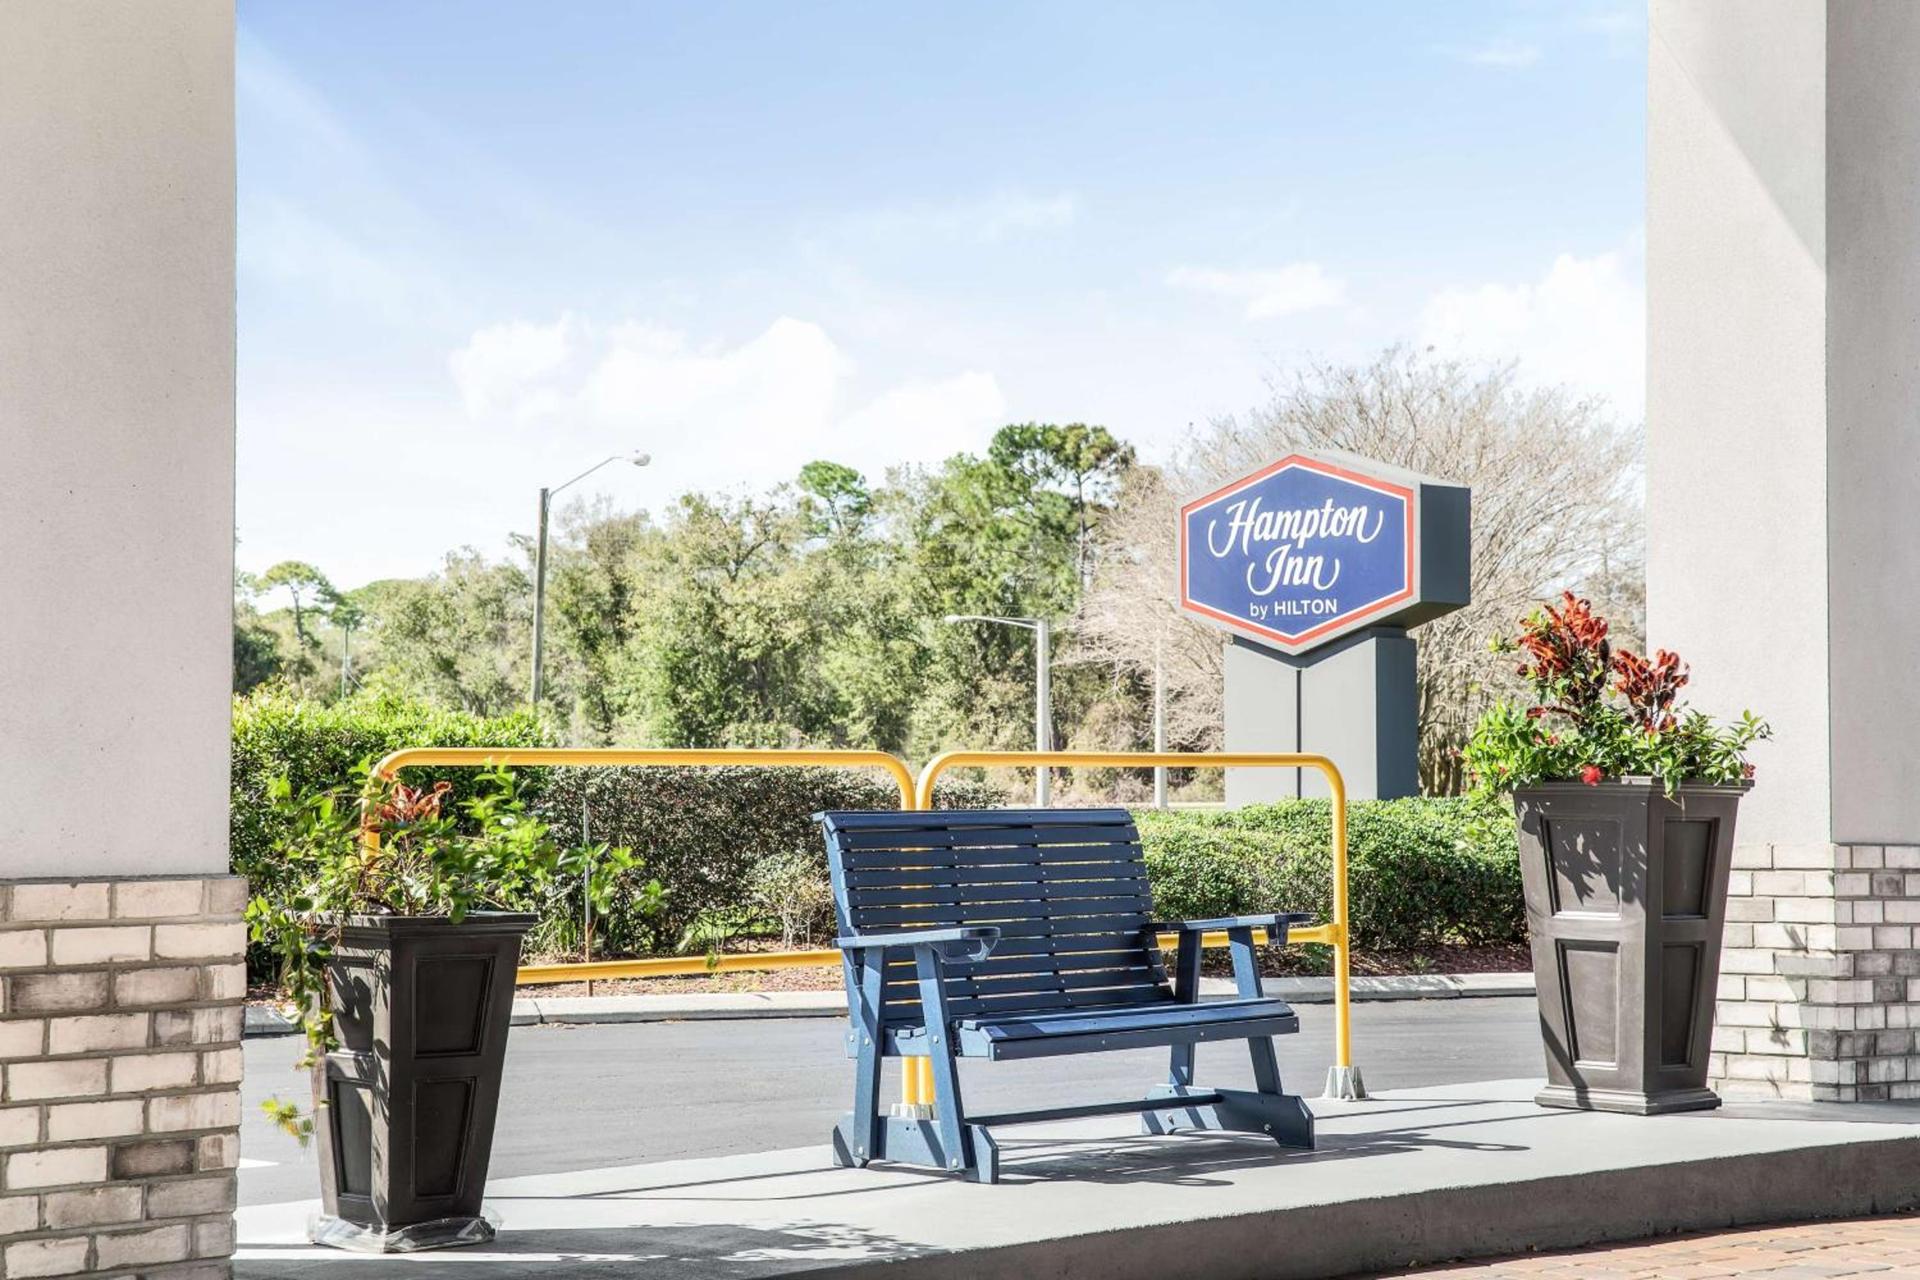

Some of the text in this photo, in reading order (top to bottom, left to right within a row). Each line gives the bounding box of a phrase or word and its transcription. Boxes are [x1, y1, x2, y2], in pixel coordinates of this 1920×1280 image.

[1207, 497, 1384, 558] Hampton
[1246, 544, 1341, 596] Inn
[1250, 599, 1338, 619] by HILTON
